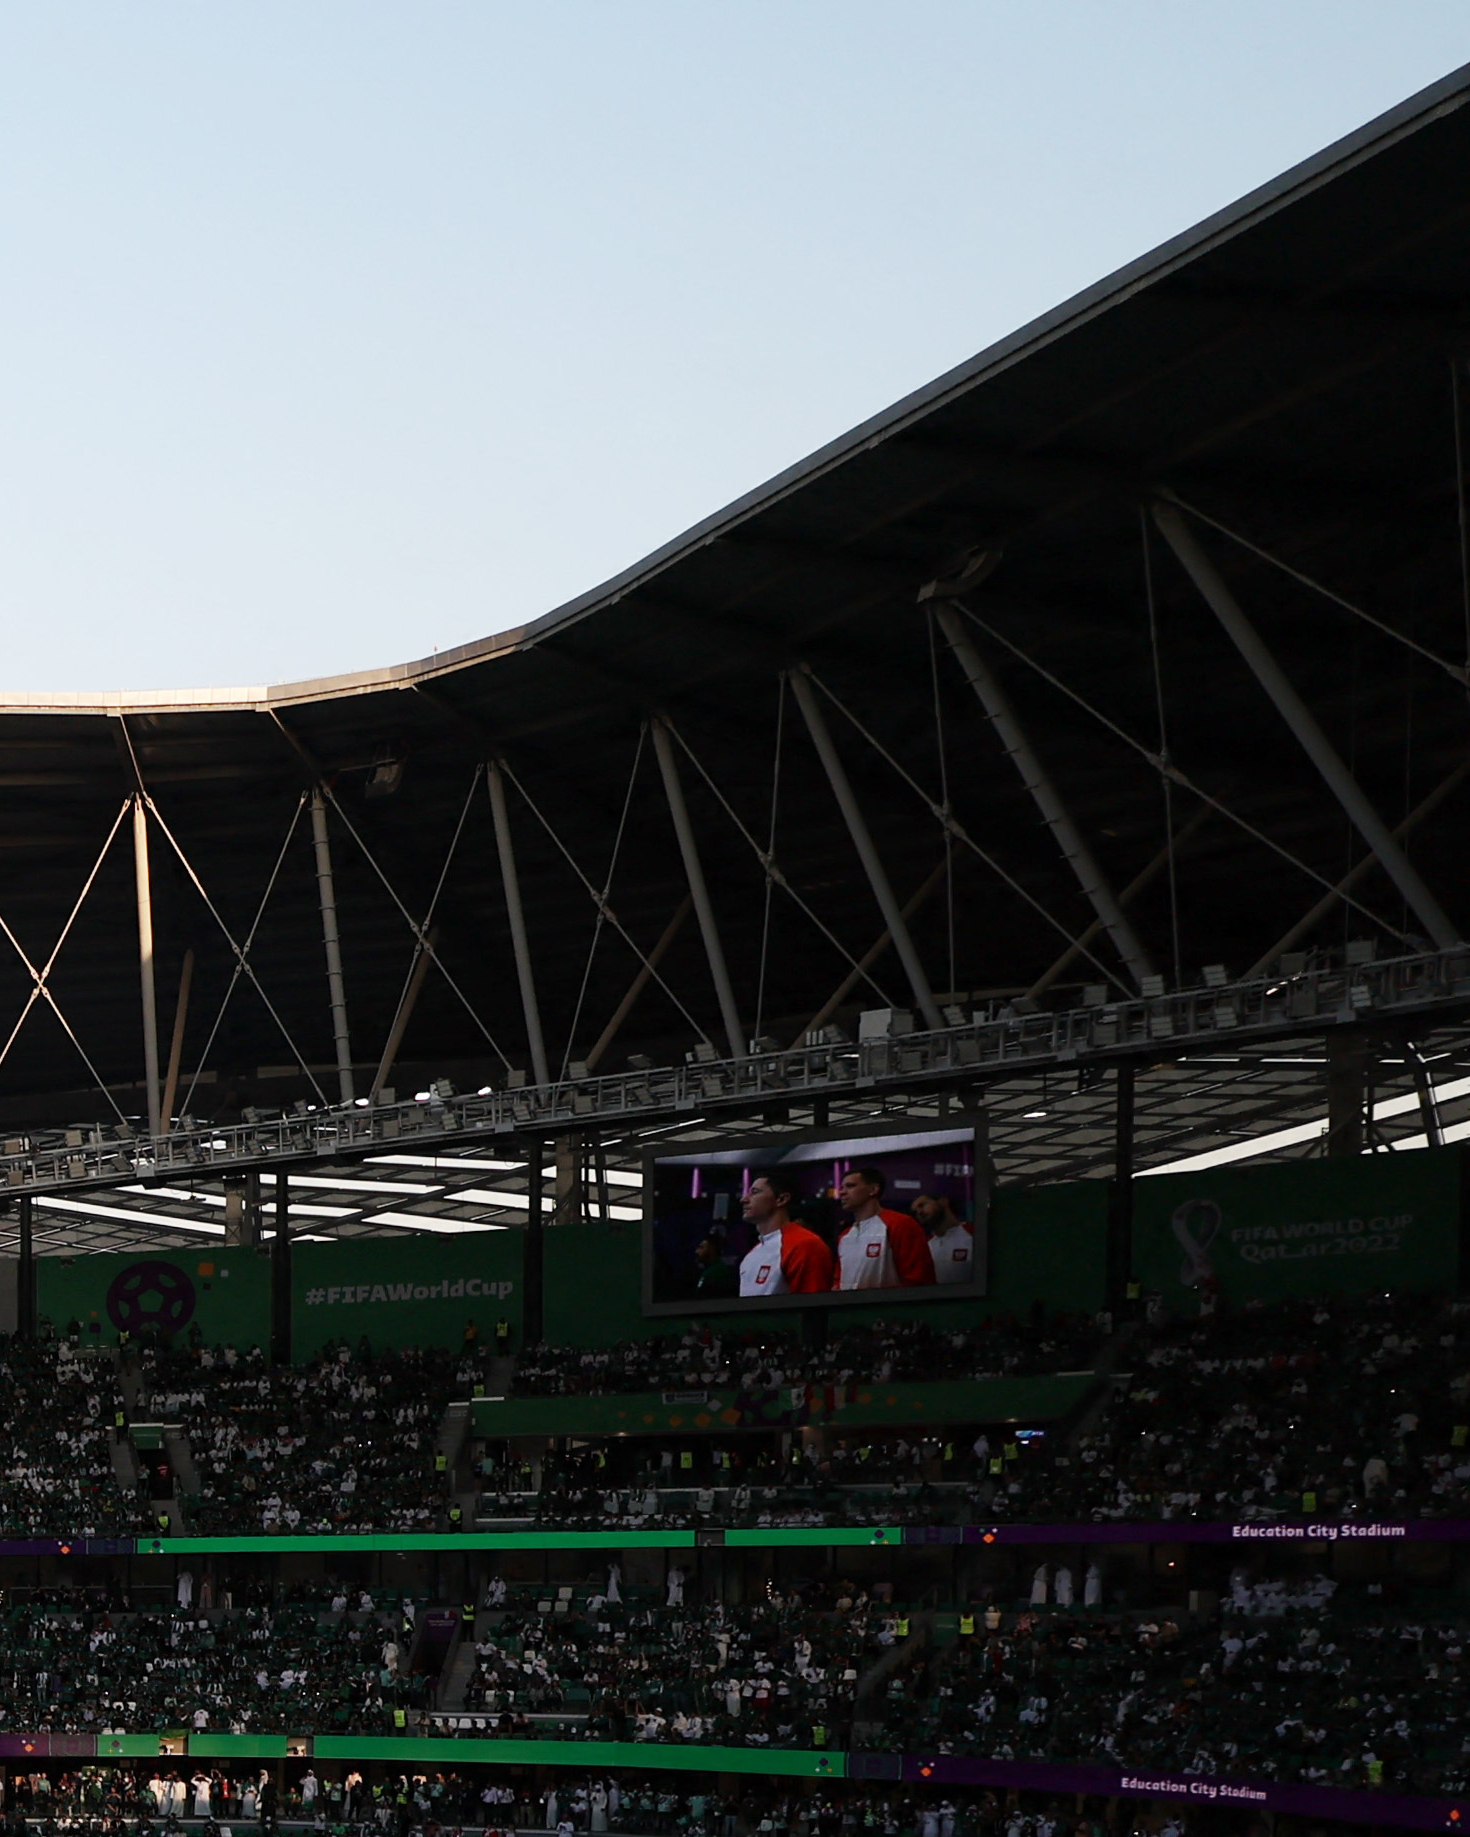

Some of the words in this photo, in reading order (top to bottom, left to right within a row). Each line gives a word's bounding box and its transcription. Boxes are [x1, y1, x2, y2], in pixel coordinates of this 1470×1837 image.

[305, 1278, 513, 1306] #FIFAWorldCup
[1232, 1525, 1305, 1538] Education
[1307, 1524, 1338, 1540] City
[1340, 1524, 1406, 1537] Stadium
[1121, 1777, 1188, 1793] Education
[1189, 1782, 1218, 1799] City
[1219, 1784, 1268, 1801] Stadium
